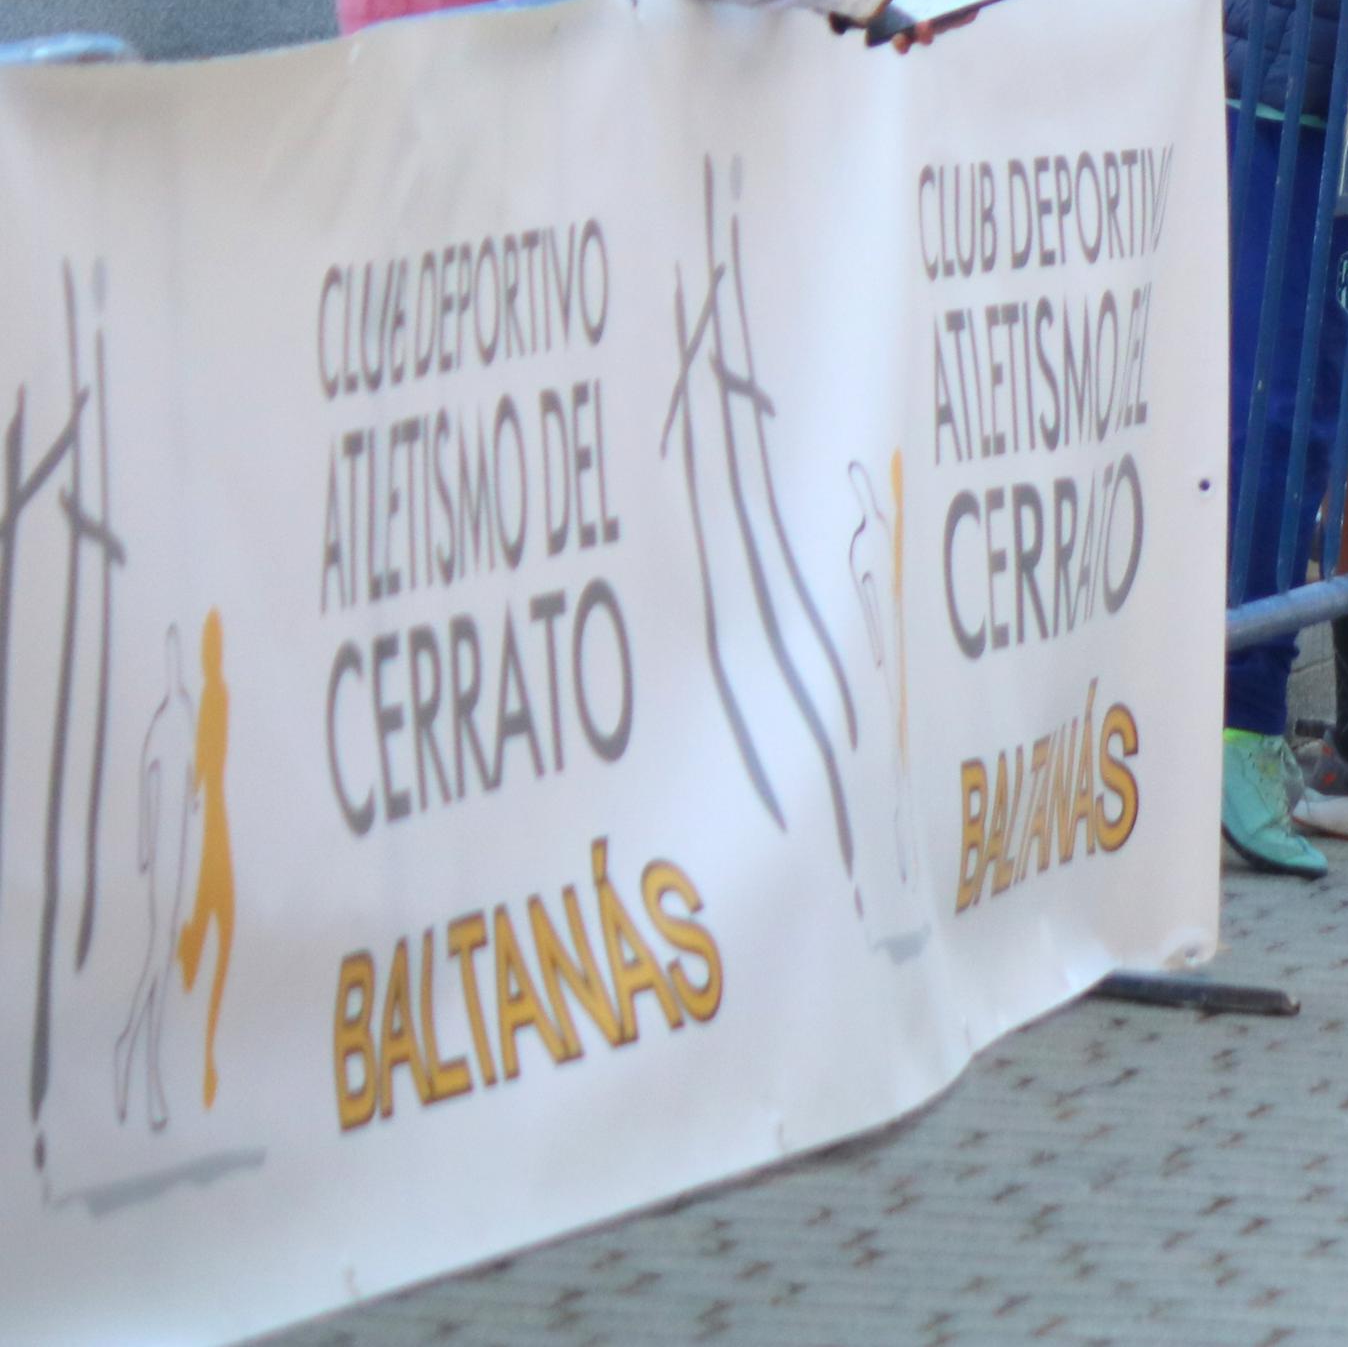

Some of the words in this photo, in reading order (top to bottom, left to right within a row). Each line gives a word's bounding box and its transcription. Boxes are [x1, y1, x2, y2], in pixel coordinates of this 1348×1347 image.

[414, 216, 610, 381] DEPORTIVO
[917, 159, 999, 282] CLUB
[1007, 142, 1173, 269] DEPORTIV
[933, 287, 1120, 467] ATLETISMO
[319, 392, 528, 621] ATLETISMO
[538, 378, 621, 558] DEL
[943, 453, 1145, 662] CERRATO
[325, 576, 634, 838] CERRATO
[955, 676, 1140, 916] BALTANÁS
[332, 834, 724, 1134] BALTANÁS
